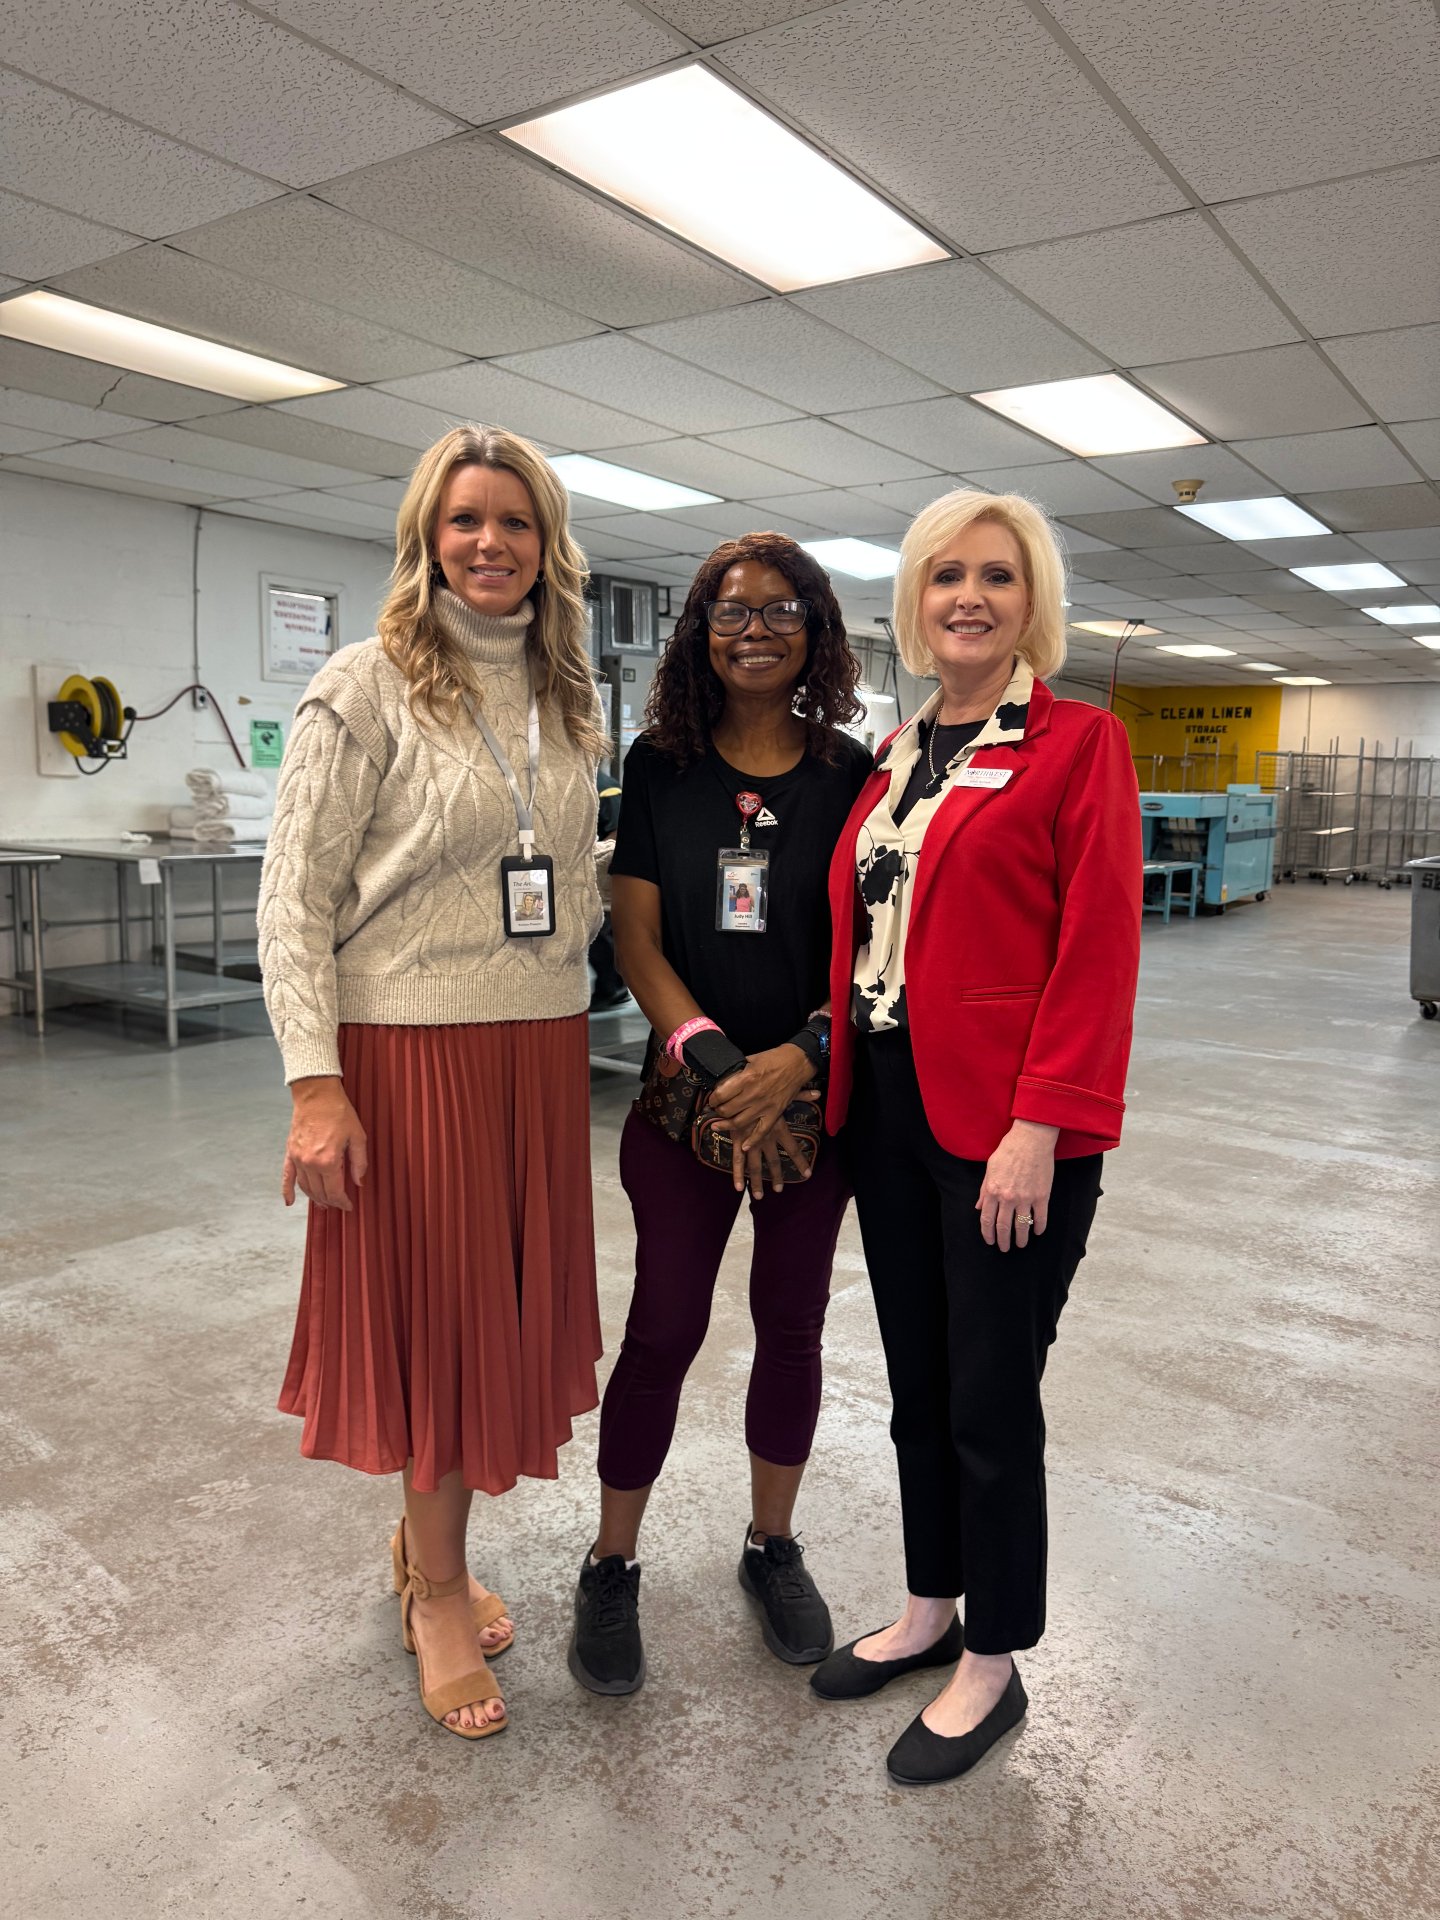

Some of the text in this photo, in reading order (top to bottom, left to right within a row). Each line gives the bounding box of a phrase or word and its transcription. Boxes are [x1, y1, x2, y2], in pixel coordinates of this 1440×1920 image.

[1161, 706, 1252, 719] CLEAN LINEN
[1185, 725, 1228, 733] STORAGE
[1194, 735, 1218, 744] AREA
[755, 819, 779, 828] Reebok
